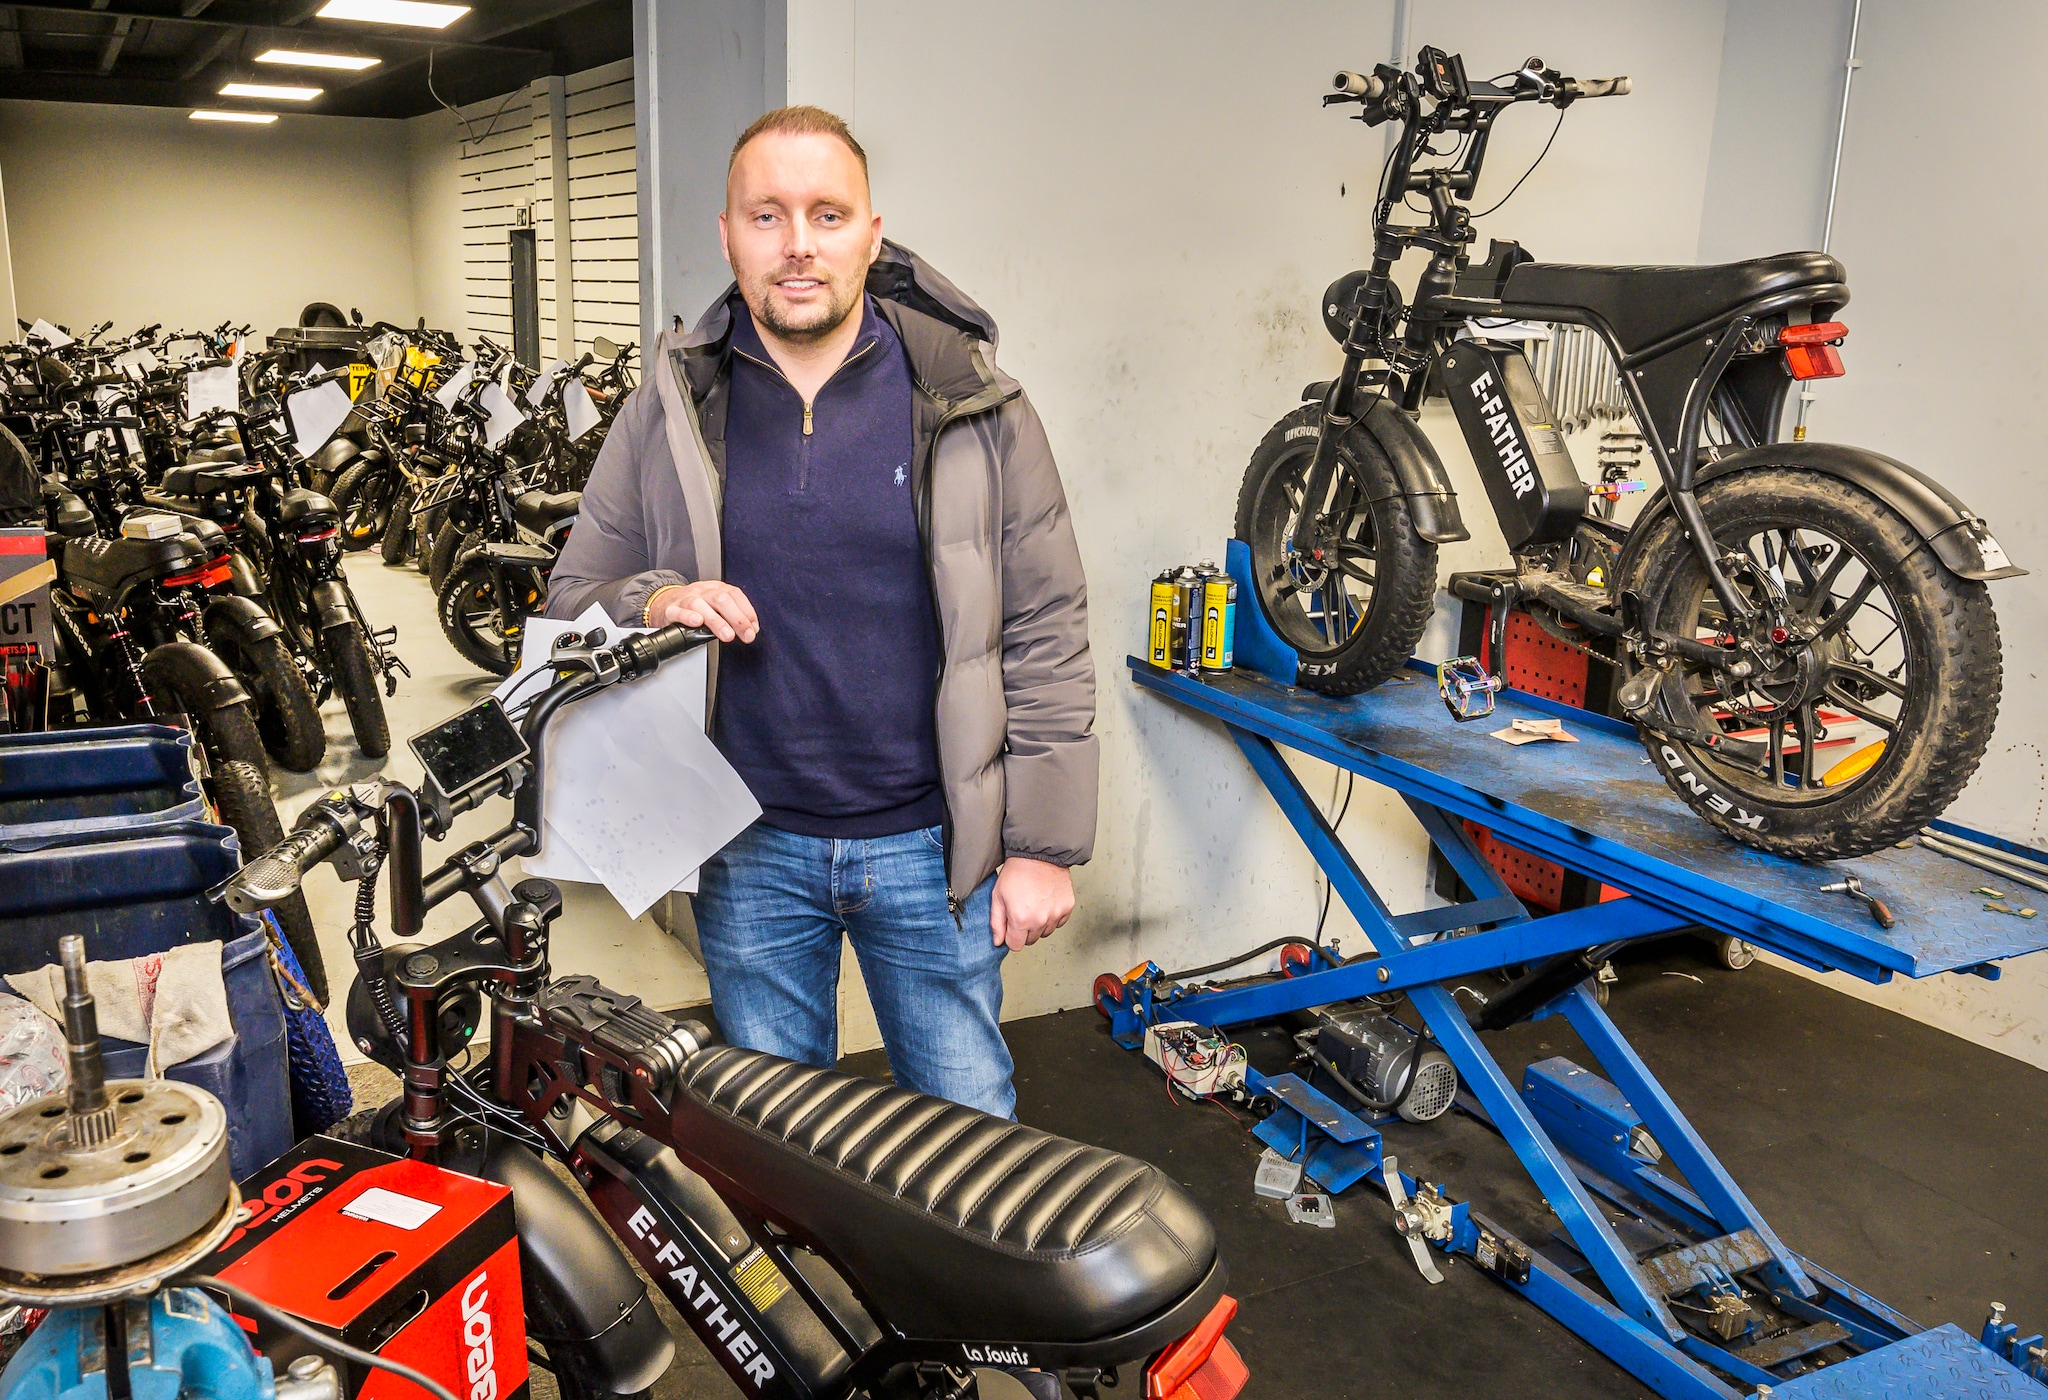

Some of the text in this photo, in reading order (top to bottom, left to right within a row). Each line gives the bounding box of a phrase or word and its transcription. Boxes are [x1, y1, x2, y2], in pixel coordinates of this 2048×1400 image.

[1470, 371, 1535, 500] E-FATHER
[0, 602, 36, 635] CT
[446, 580, 469, 628] KENDA
[0, 645, 36, 655] METS.CM
[1297, 660, 1338, 676] KEN
[1660, 745, 1766, 831] KEND
[271, 1186, 324, 1223] HELMETS
[626, 1204, 776, 1389] E-FATHER
[961, 1343, 1029, 1366] La Souris
